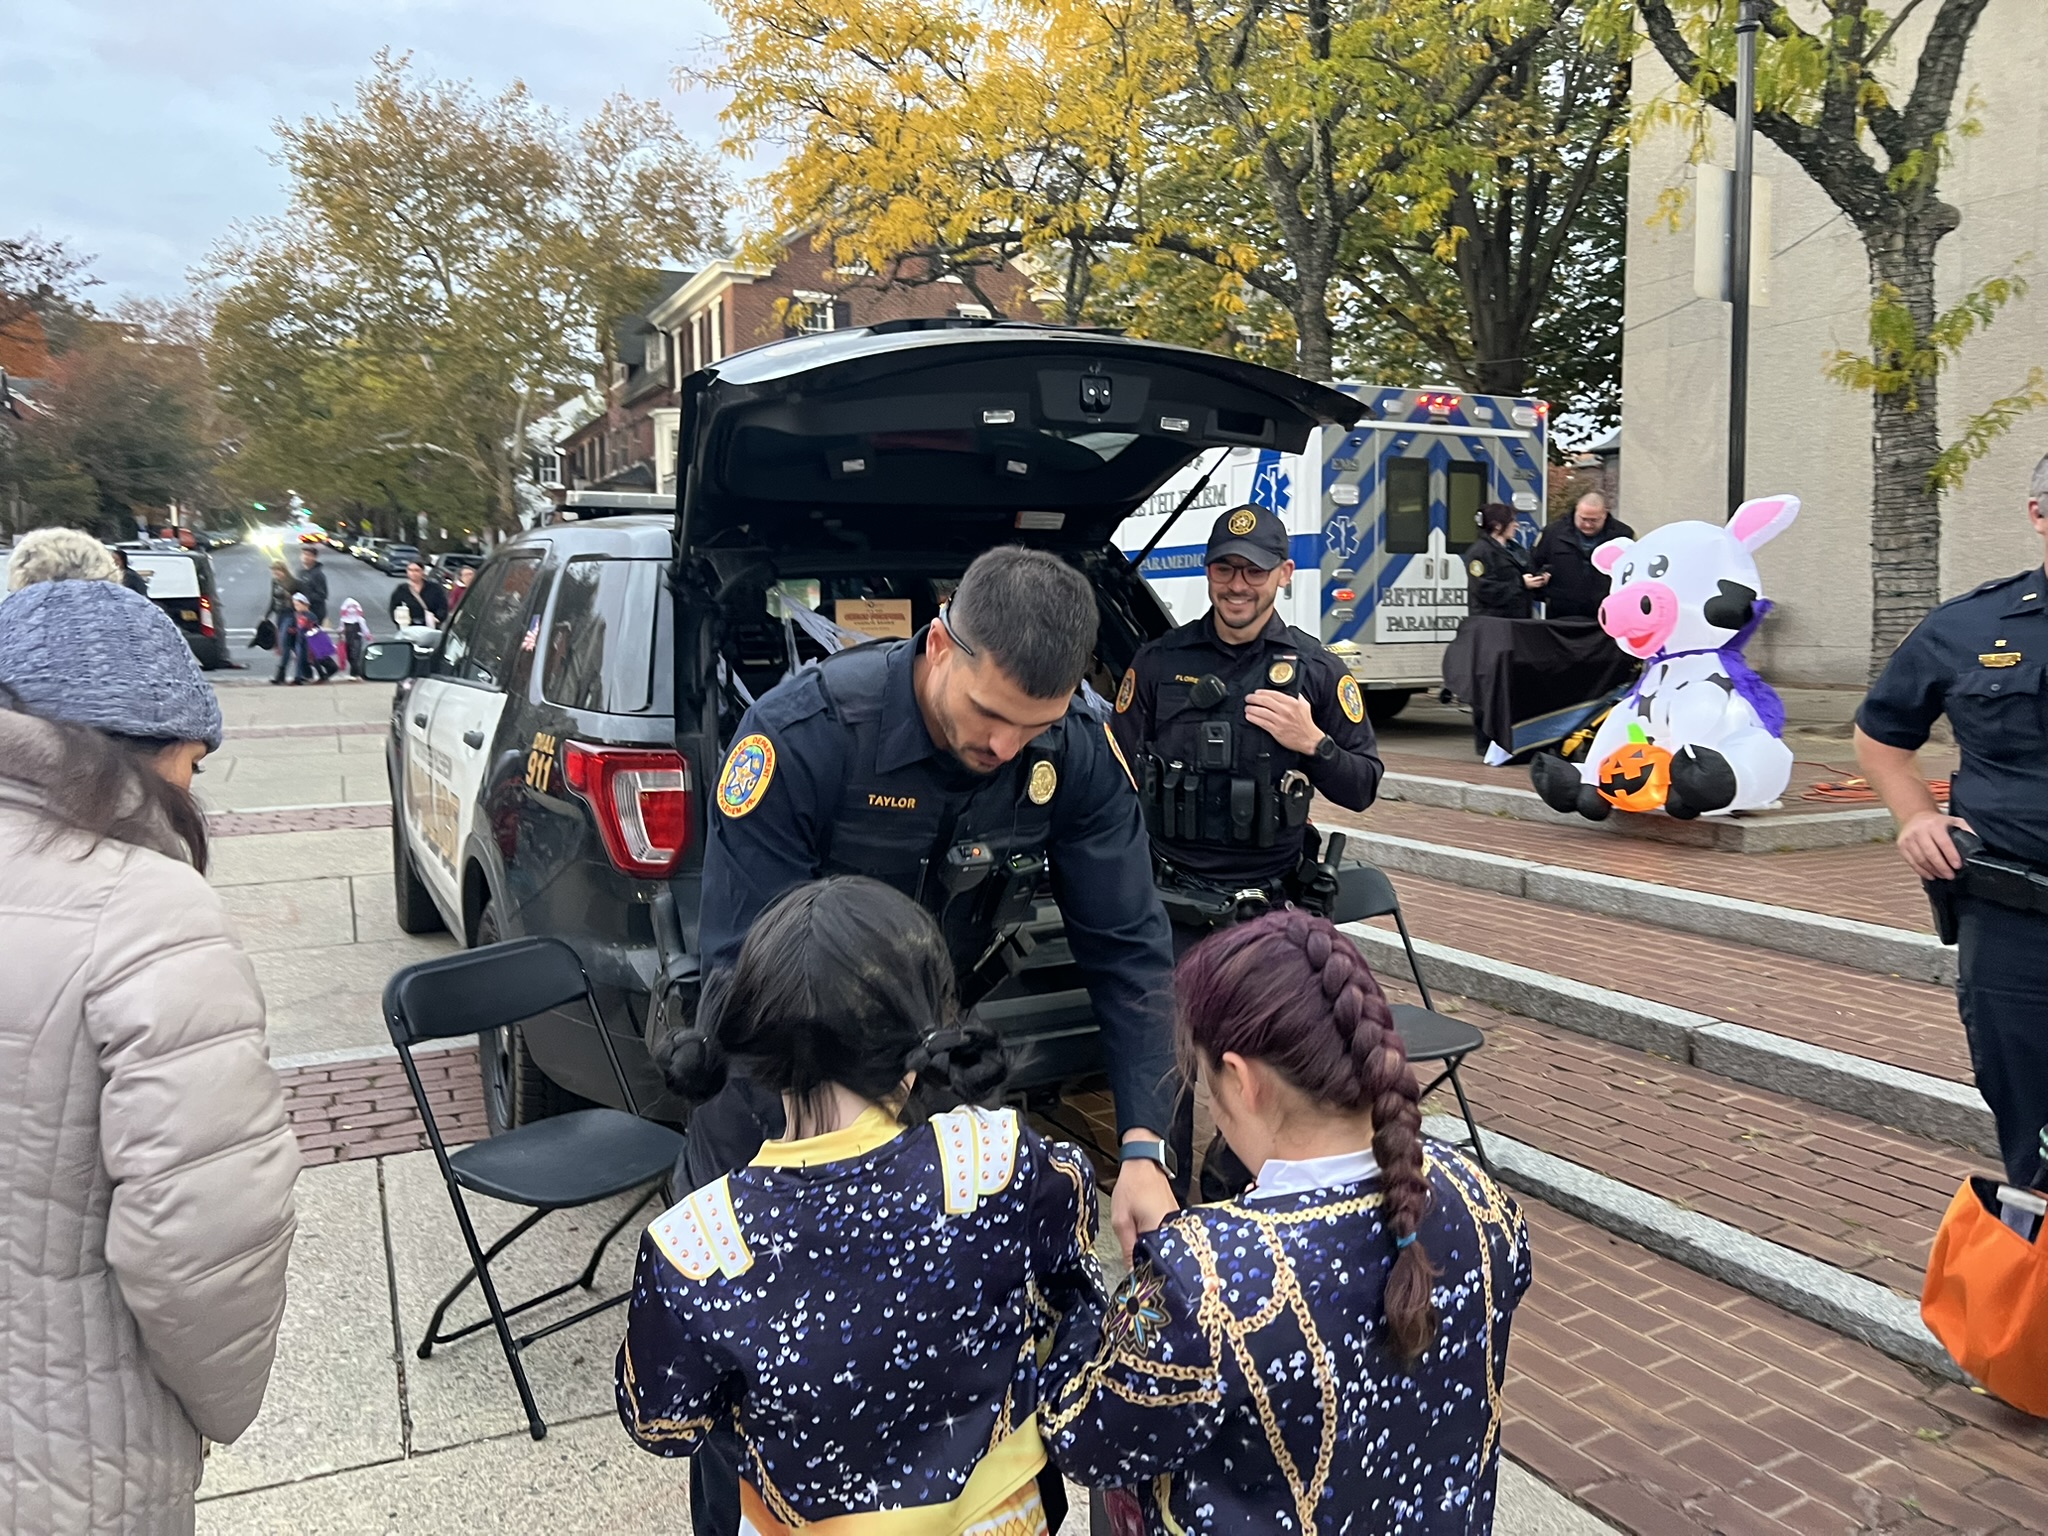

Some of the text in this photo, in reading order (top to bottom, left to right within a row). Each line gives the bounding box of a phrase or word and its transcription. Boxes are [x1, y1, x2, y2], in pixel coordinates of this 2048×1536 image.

[1331, 458, 1359, 471] EMS
[1381, 588, 1468, 606] BETHLEH
[1386, 616, 1468, 632] PARAMED
[532, 732, 556, 755] DIAL
[752, 737, 773, 779] DEPARTMENT
[525, 751, 553, 792] 911
[868, 794, 916, 809] TAYLOR
